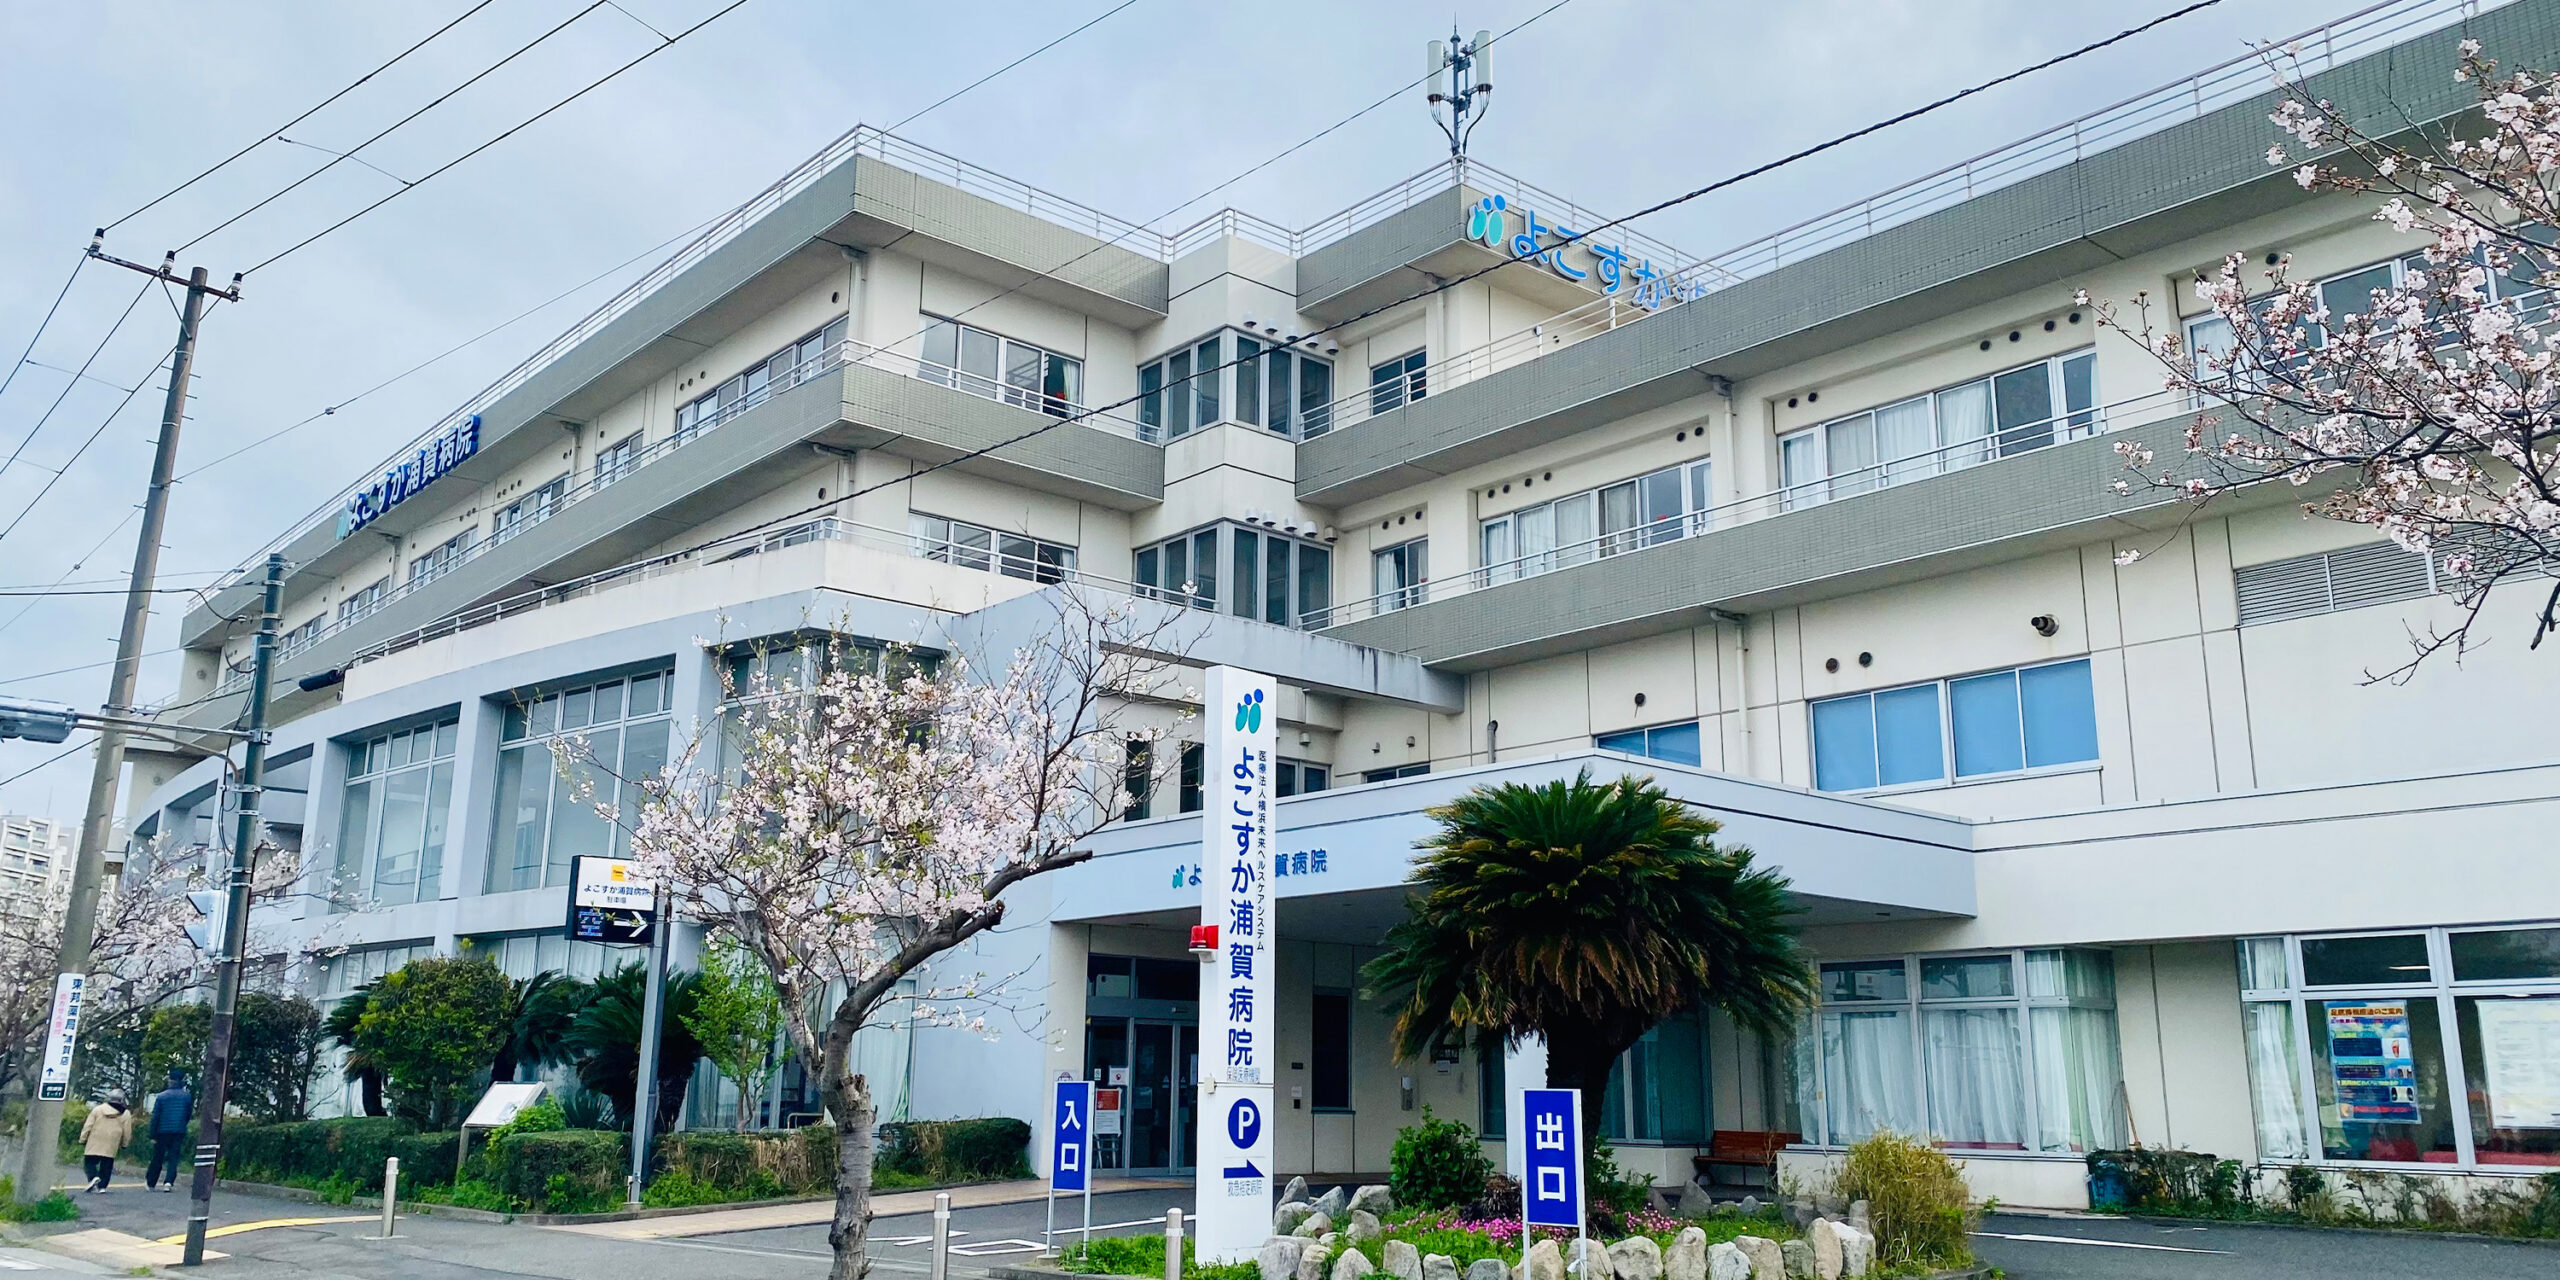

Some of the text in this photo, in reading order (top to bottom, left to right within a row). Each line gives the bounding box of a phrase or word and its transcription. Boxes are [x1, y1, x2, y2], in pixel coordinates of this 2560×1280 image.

[348, 414, 480, 531] よこすか浦賀病院
[1256, 750, 1267, 951] 医療法人横浜未来ヘルスケアシステム
[1228, 746, 1255, 1066] よこすか浦賀病院
[1060, 1100, 1081, 1172] 入口
[1238, 1106, 1255, 1140] P
[1536, 1112, 1566, 1202] 出口
